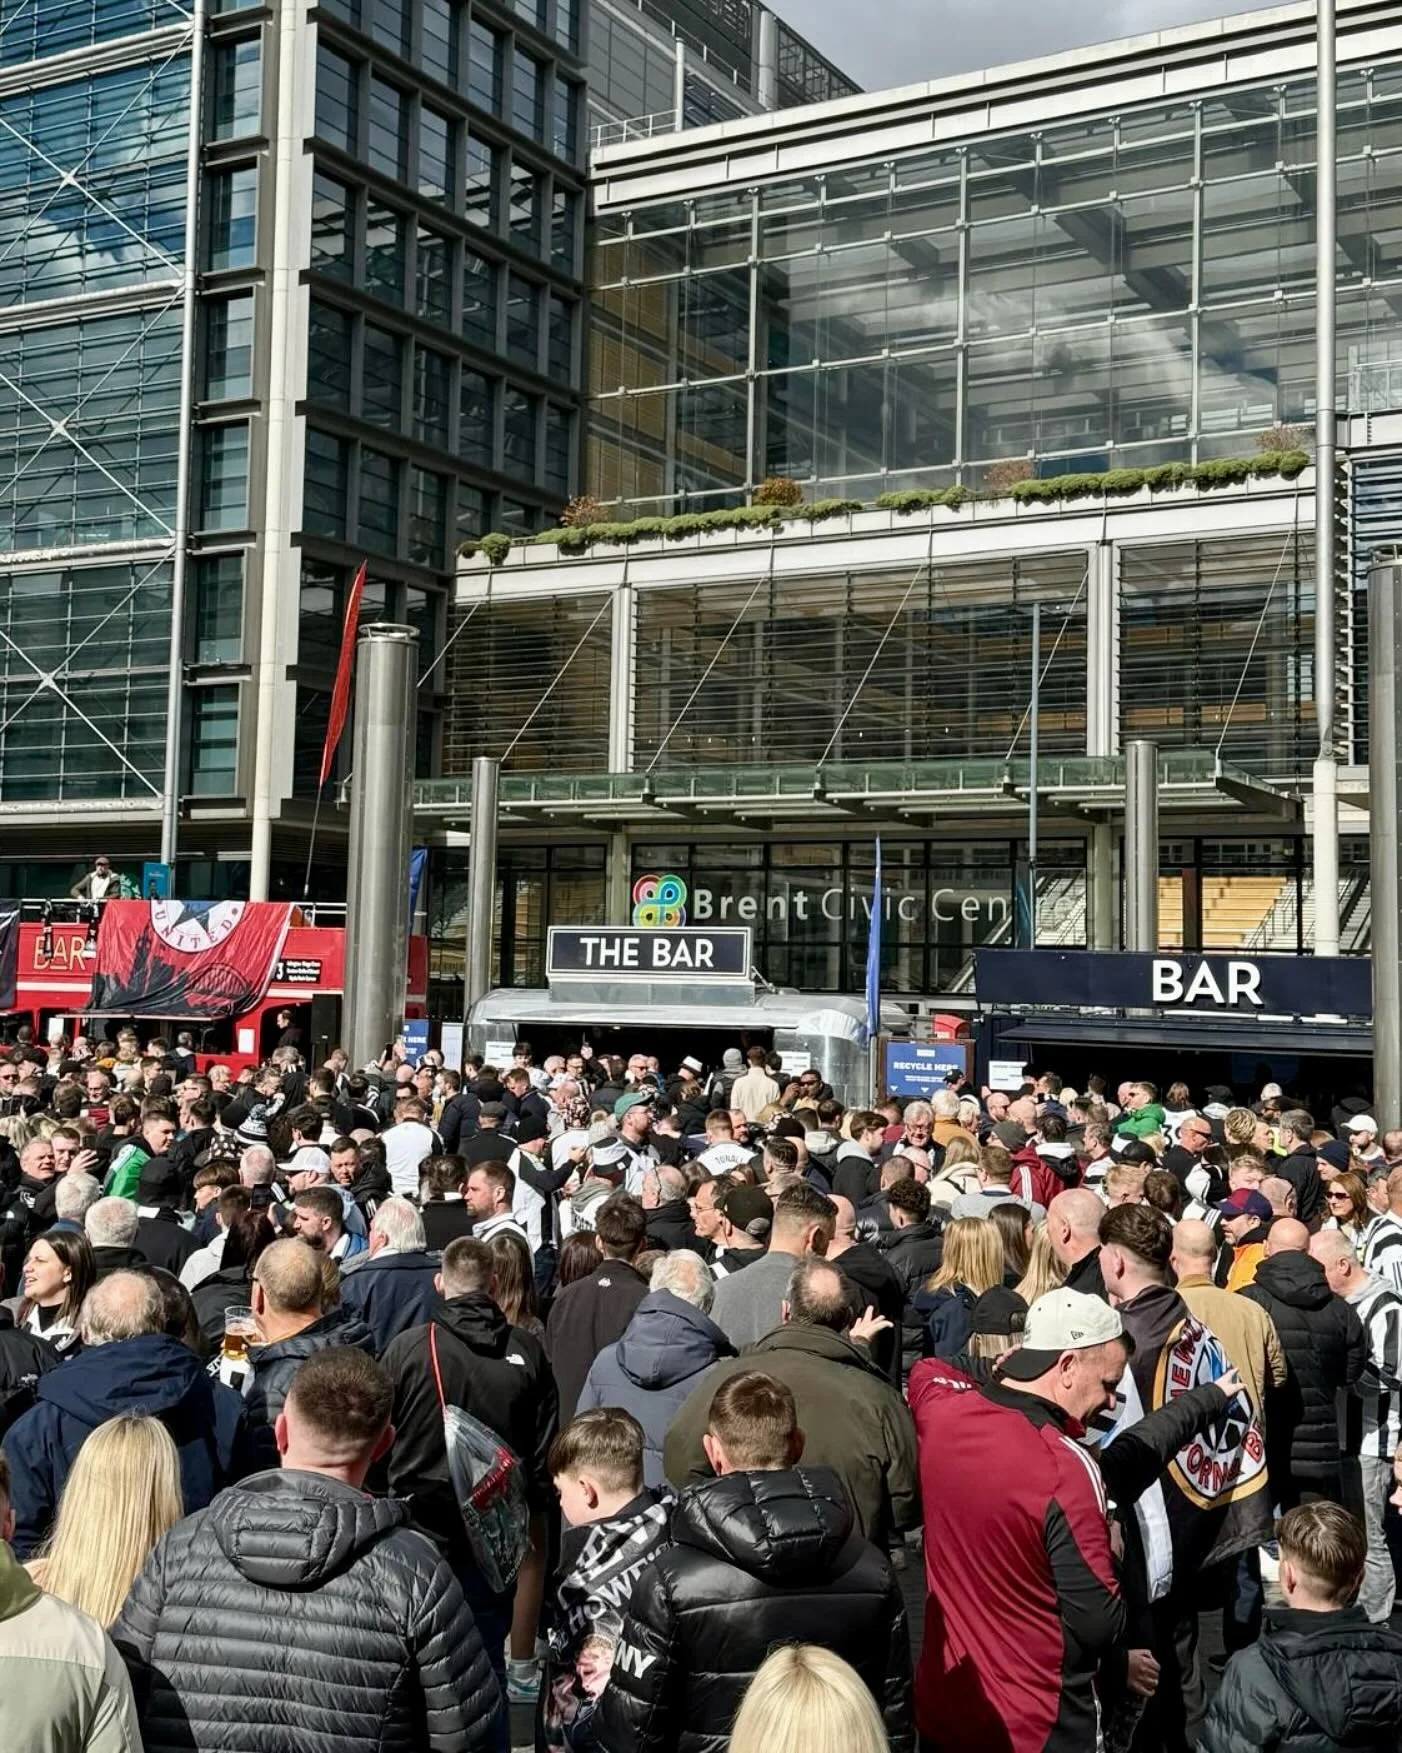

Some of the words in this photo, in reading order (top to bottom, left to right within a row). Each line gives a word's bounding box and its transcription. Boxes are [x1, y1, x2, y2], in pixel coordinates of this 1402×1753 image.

[693, 887, 808, 920] Brent
[154, 910, 234, 949] UNITED
[33, 936, 86, 970] BAR
[579, 937, 640, 966] THE
[652, 938, 714, 967] BAR
[1152, 960, 1264, 1005] BAR
[893, 1061, 933, 1070] RECYCLE
